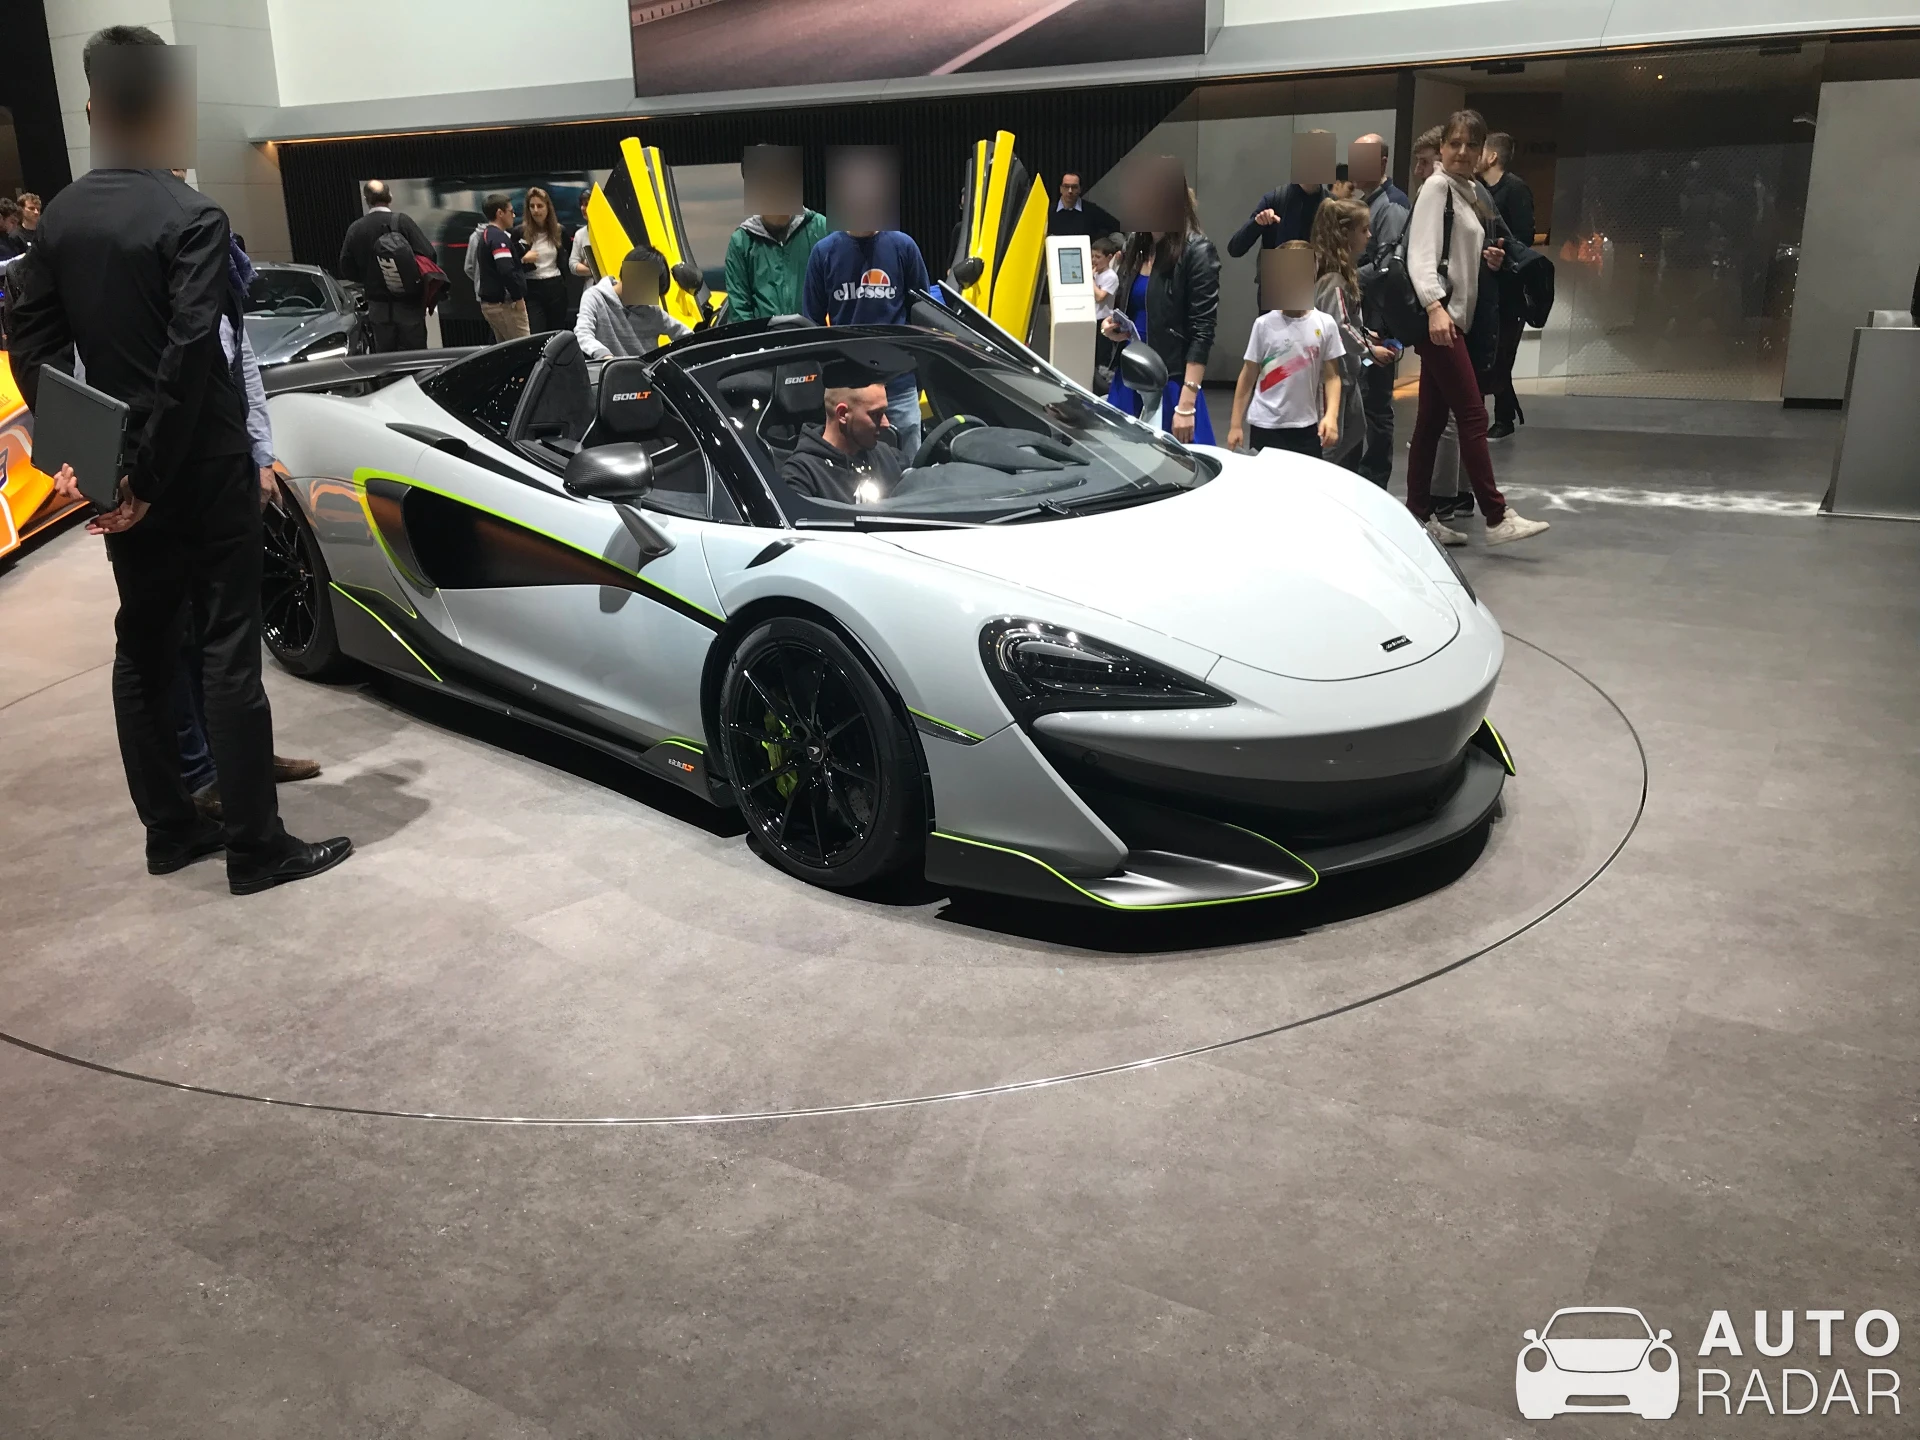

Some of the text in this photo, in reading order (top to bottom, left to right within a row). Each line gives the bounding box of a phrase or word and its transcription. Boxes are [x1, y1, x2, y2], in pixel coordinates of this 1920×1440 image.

[833, 281, 896, 301] ellesse
[784, 374, 817, 385] 600LT
[612, 391, 652, 401] 600LT
